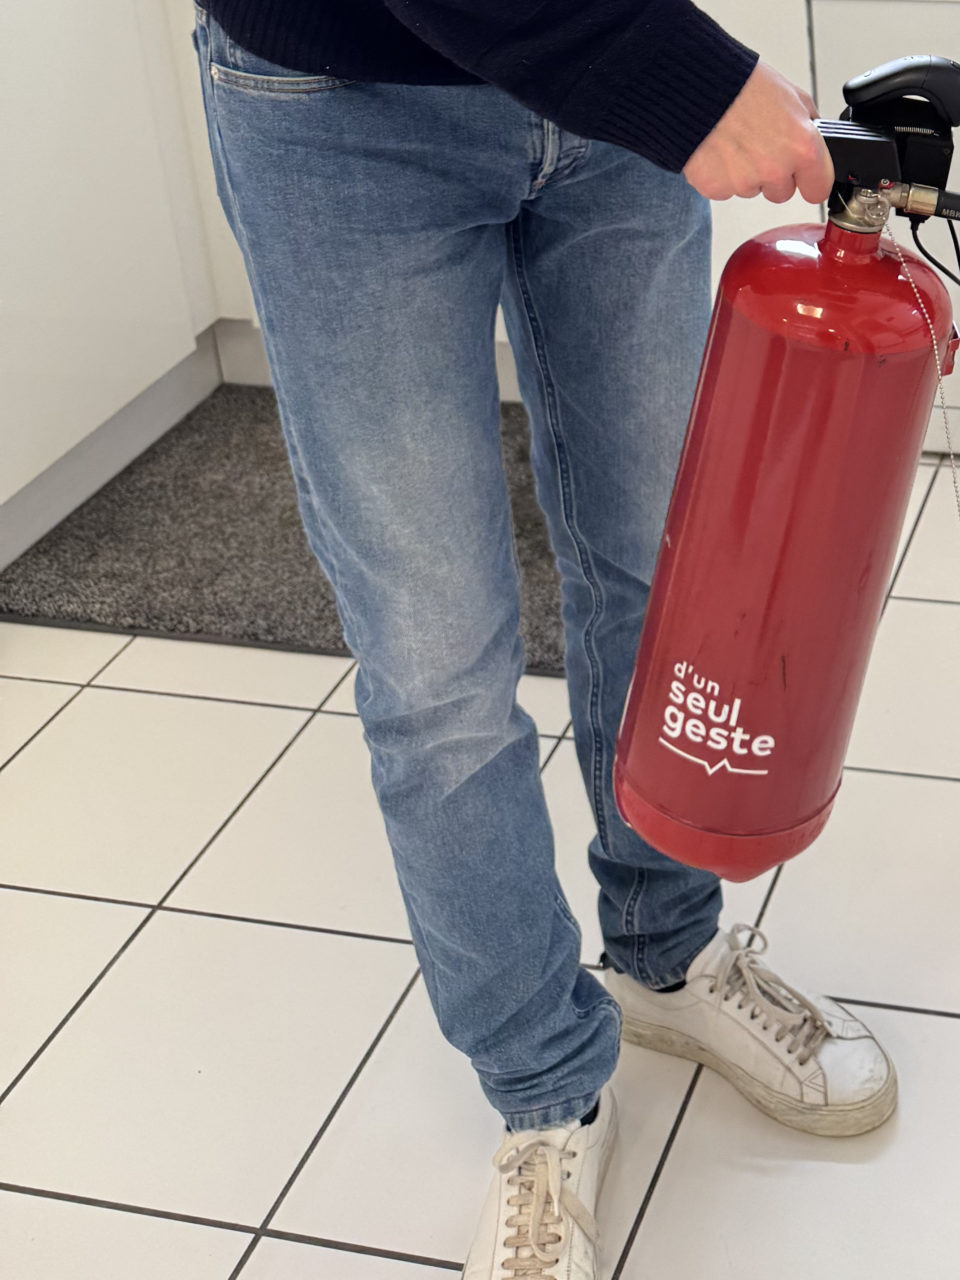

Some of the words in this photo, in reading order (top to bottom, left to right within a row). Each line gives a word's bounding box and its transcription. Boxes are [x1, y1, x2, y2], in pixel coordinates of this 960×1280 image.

[673, 660, 720, 697] d'un
[668, 680, 741, 727] seul
[662, 705, 775, 757] geste
